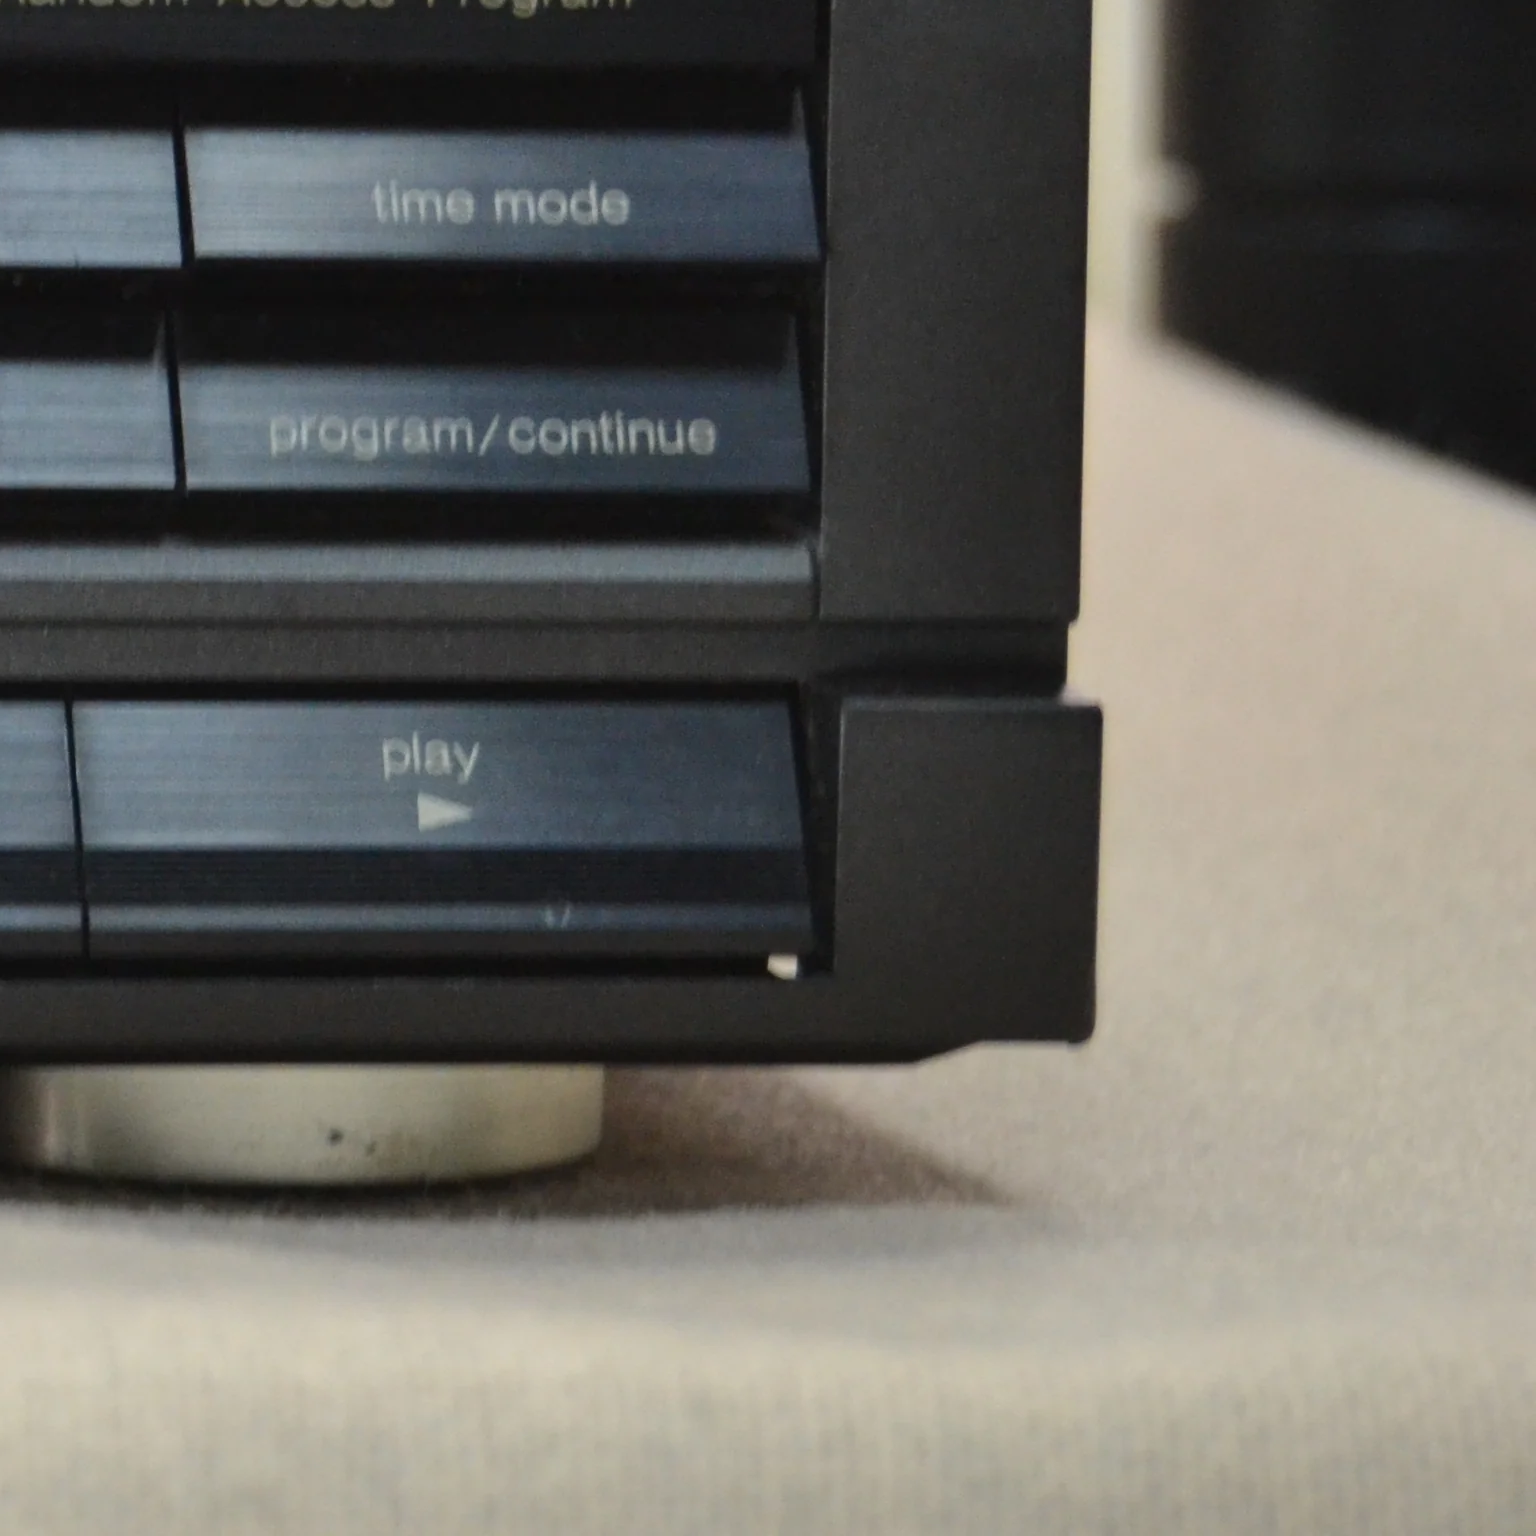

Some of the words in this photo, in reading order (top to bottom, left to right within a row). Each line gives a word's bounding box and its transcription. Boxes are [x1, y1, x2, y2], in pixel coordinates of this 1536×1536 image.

[371, 181, 475, 226] time
[494, 181, 631, 226] mode
[268, 409, 718, 462] program/continue
[380, 730, 482, 785] play
